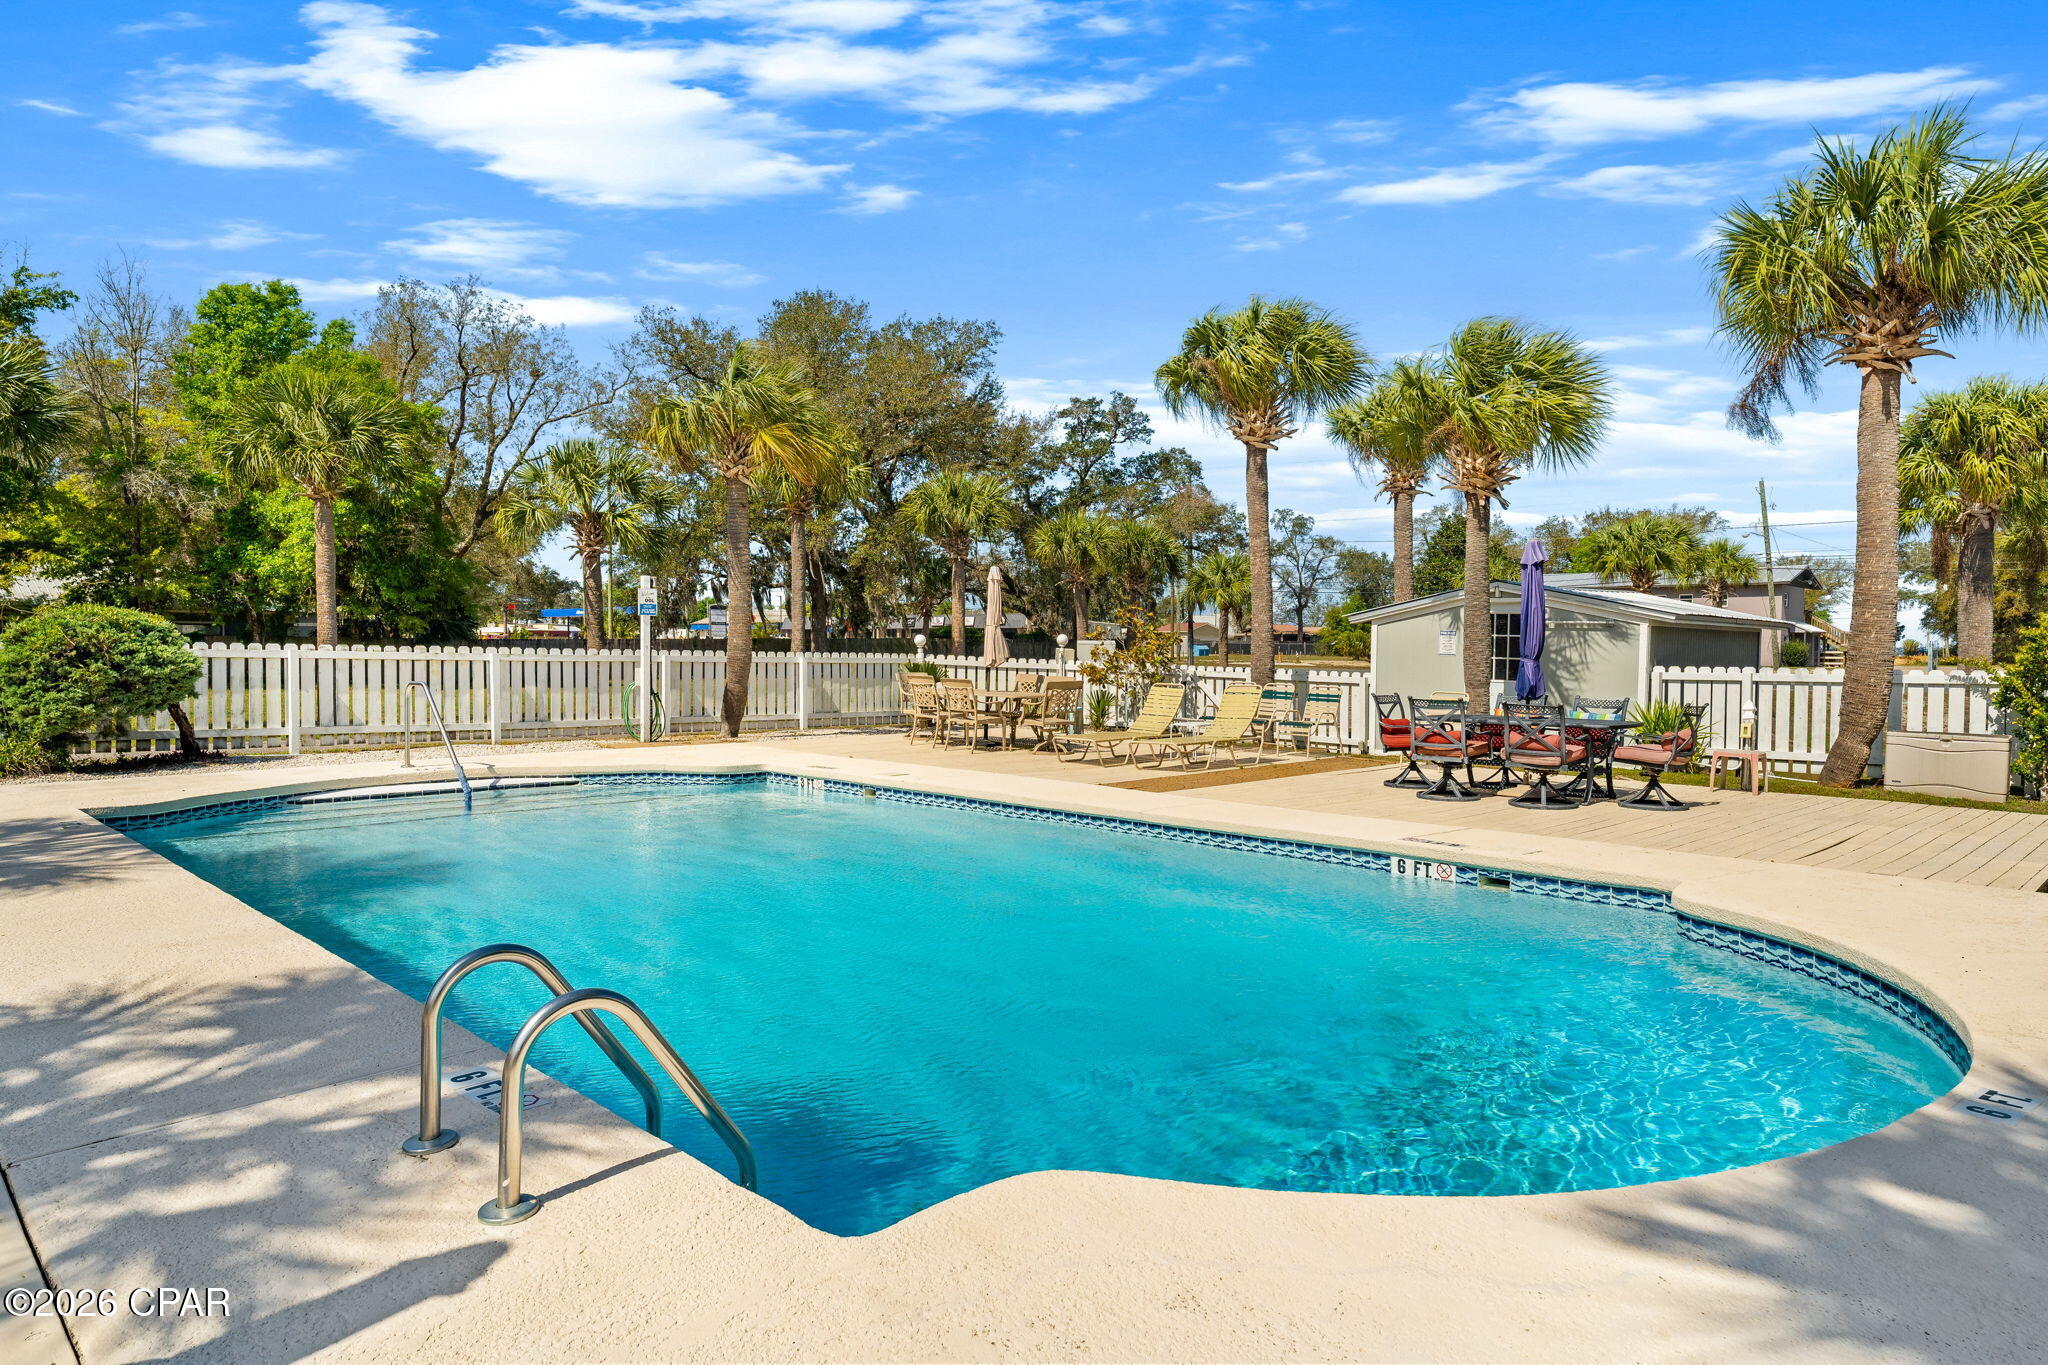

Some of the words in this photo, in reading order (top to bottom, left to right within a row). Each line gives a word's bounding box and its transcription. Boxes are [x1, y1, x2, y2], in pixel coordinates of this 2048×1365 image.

[800, 777, 804, 788] 3
[1397, 858, 1407, 874] 6
[1413, 861, 1432, 879] FT.
[450, 1070, 488, 1083] 6
[1965, 1105, 2012, 1119] 6
